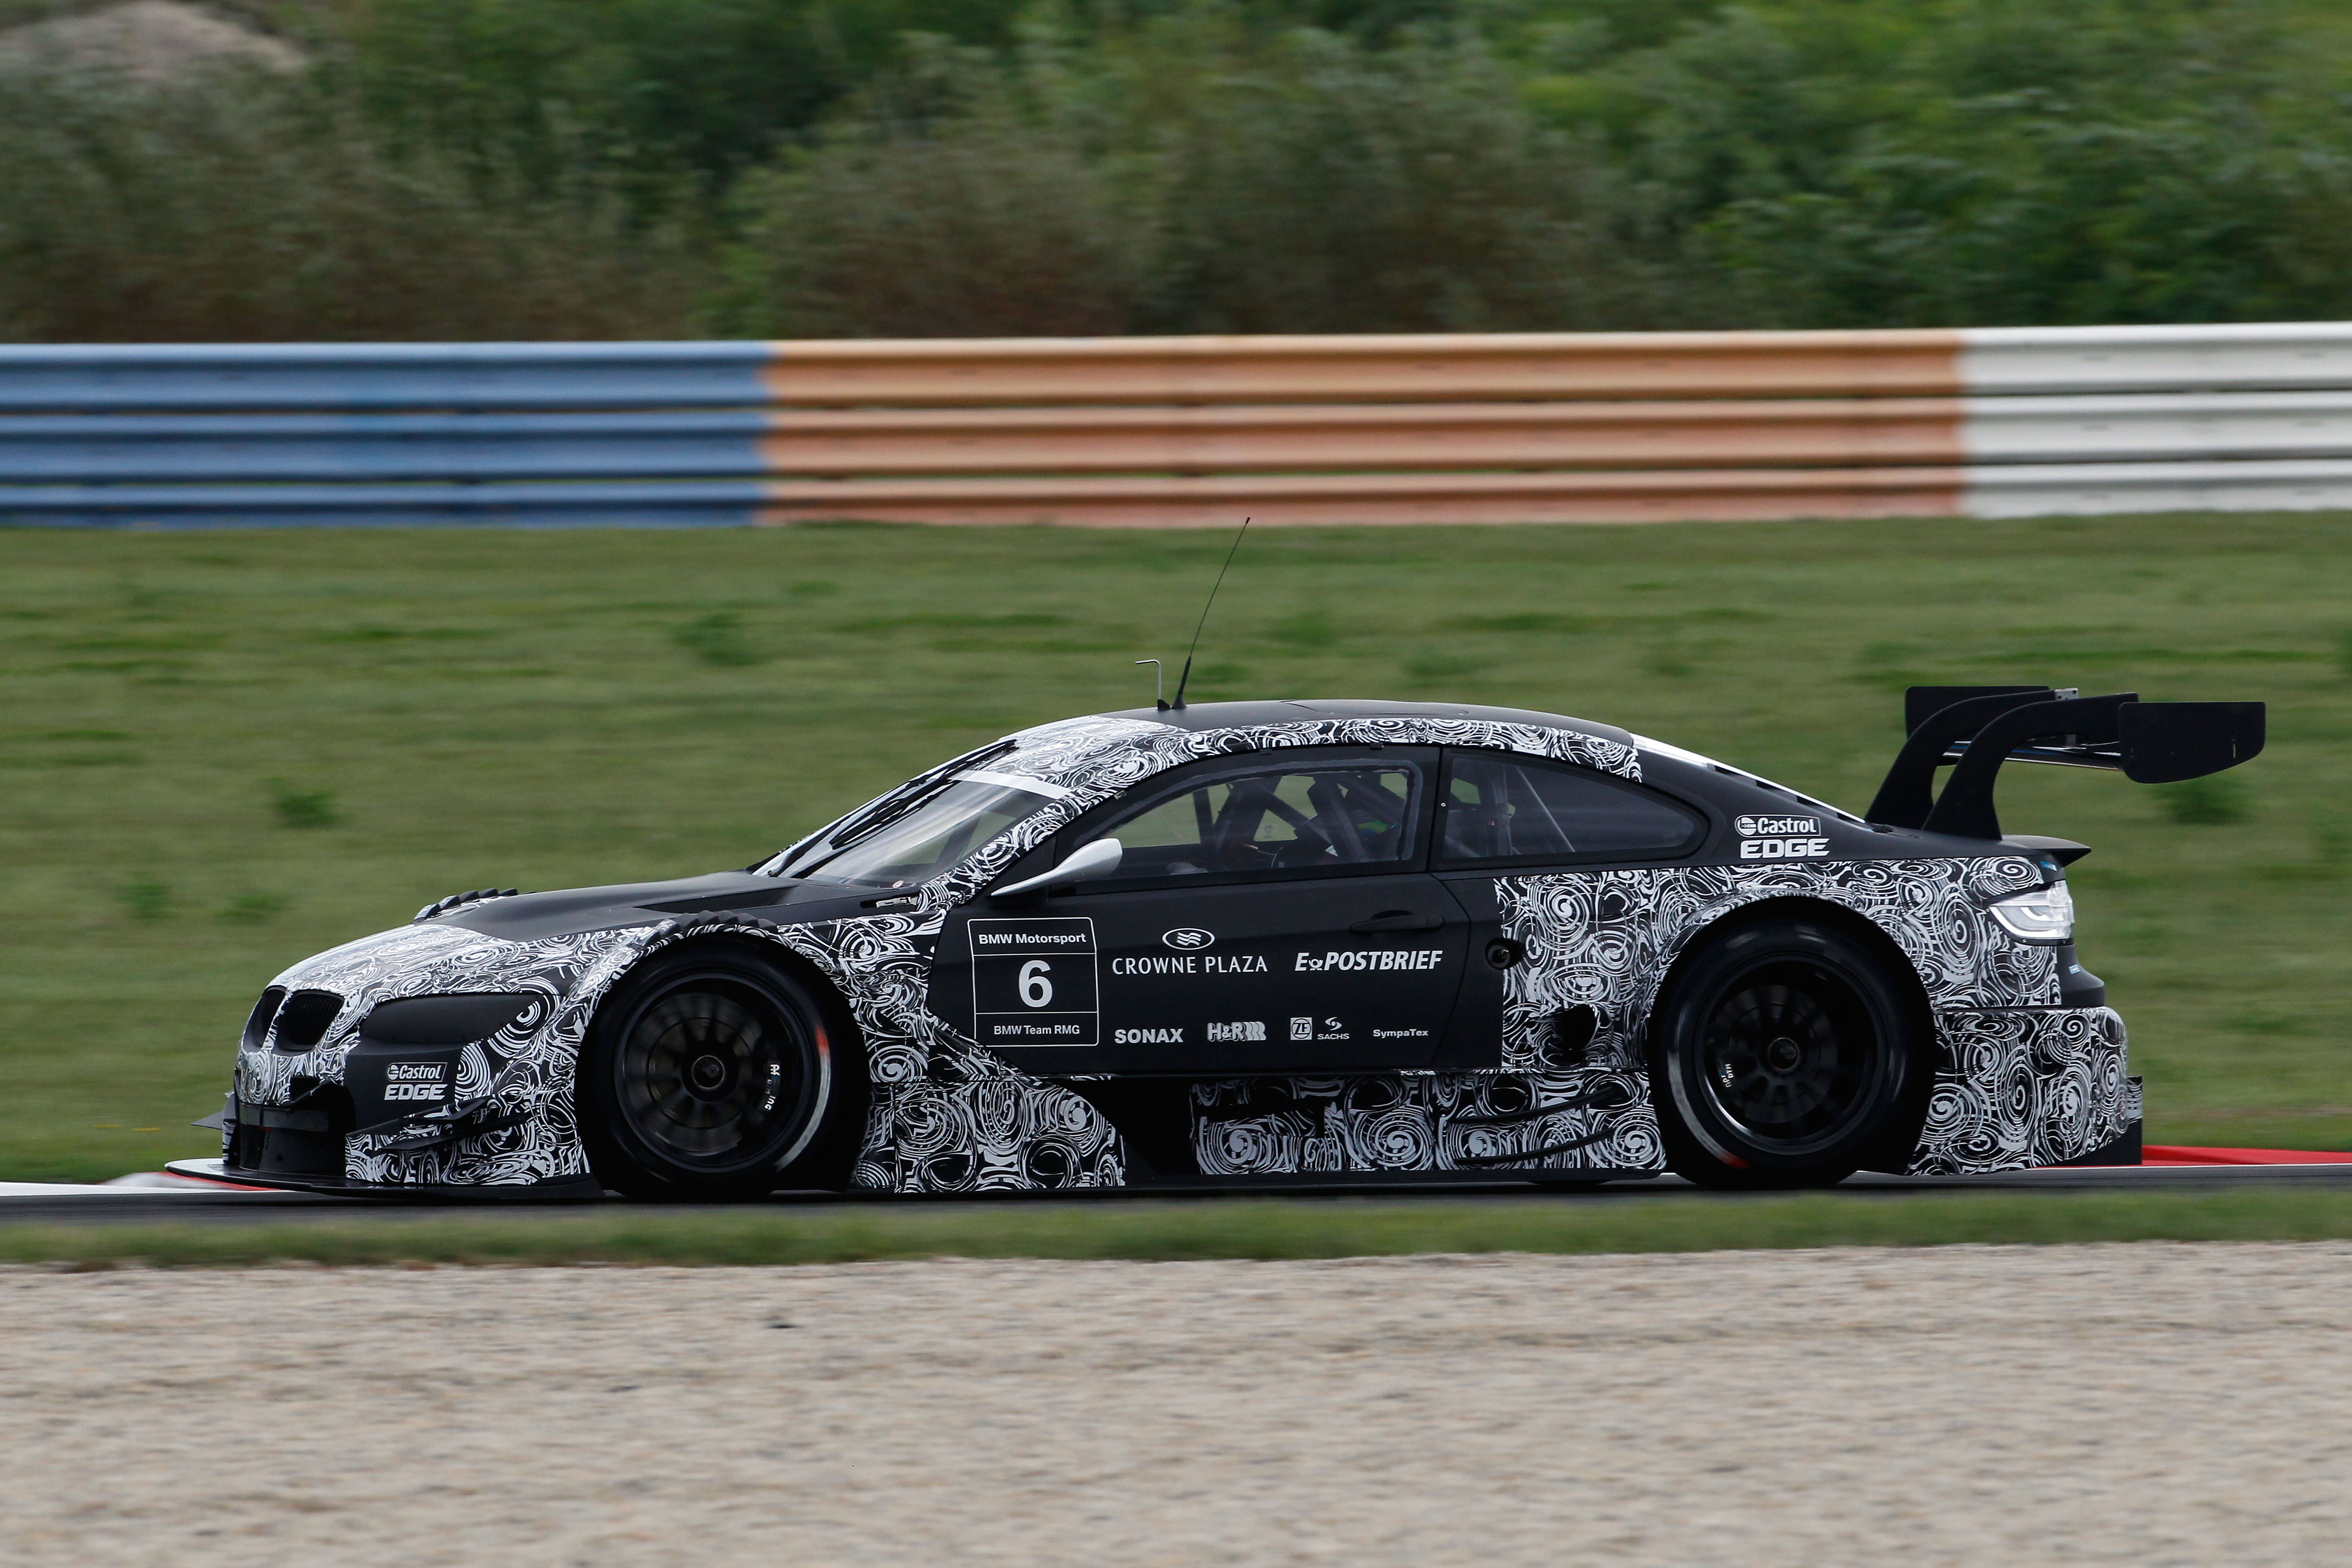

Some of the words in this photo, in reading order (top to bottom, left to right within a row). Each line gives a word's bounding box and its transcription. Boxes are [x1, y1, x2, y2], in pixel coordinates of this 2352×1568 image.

[1757, 816, 1817, 835] Castrol
[1740, 838, 1830, 859] EDGE
[978, 933, 1012, 944] BMW
[1015, 933, 1087, 945] Motorsport
[1112, 956, 1196, 974] CROWNE
[1205, 955, 1268, 973] PLAZA
[1018, 960, 1053, 1008] 6
[994, 1025, 1022, 1035] BMW
[1023, 1025, 1052, 1034] Team
[1054, 1024, 1080, 1034] RMG
[1114, 1028, 1184, 1044] SONAX
[1292, 1021, 1310, 1036] ZF
[1373, 1029, 1428, 1039] SympaTex
[399, 1064, 442, 1079] Castrol
[384, 1083, 448, 1100] EDGE
